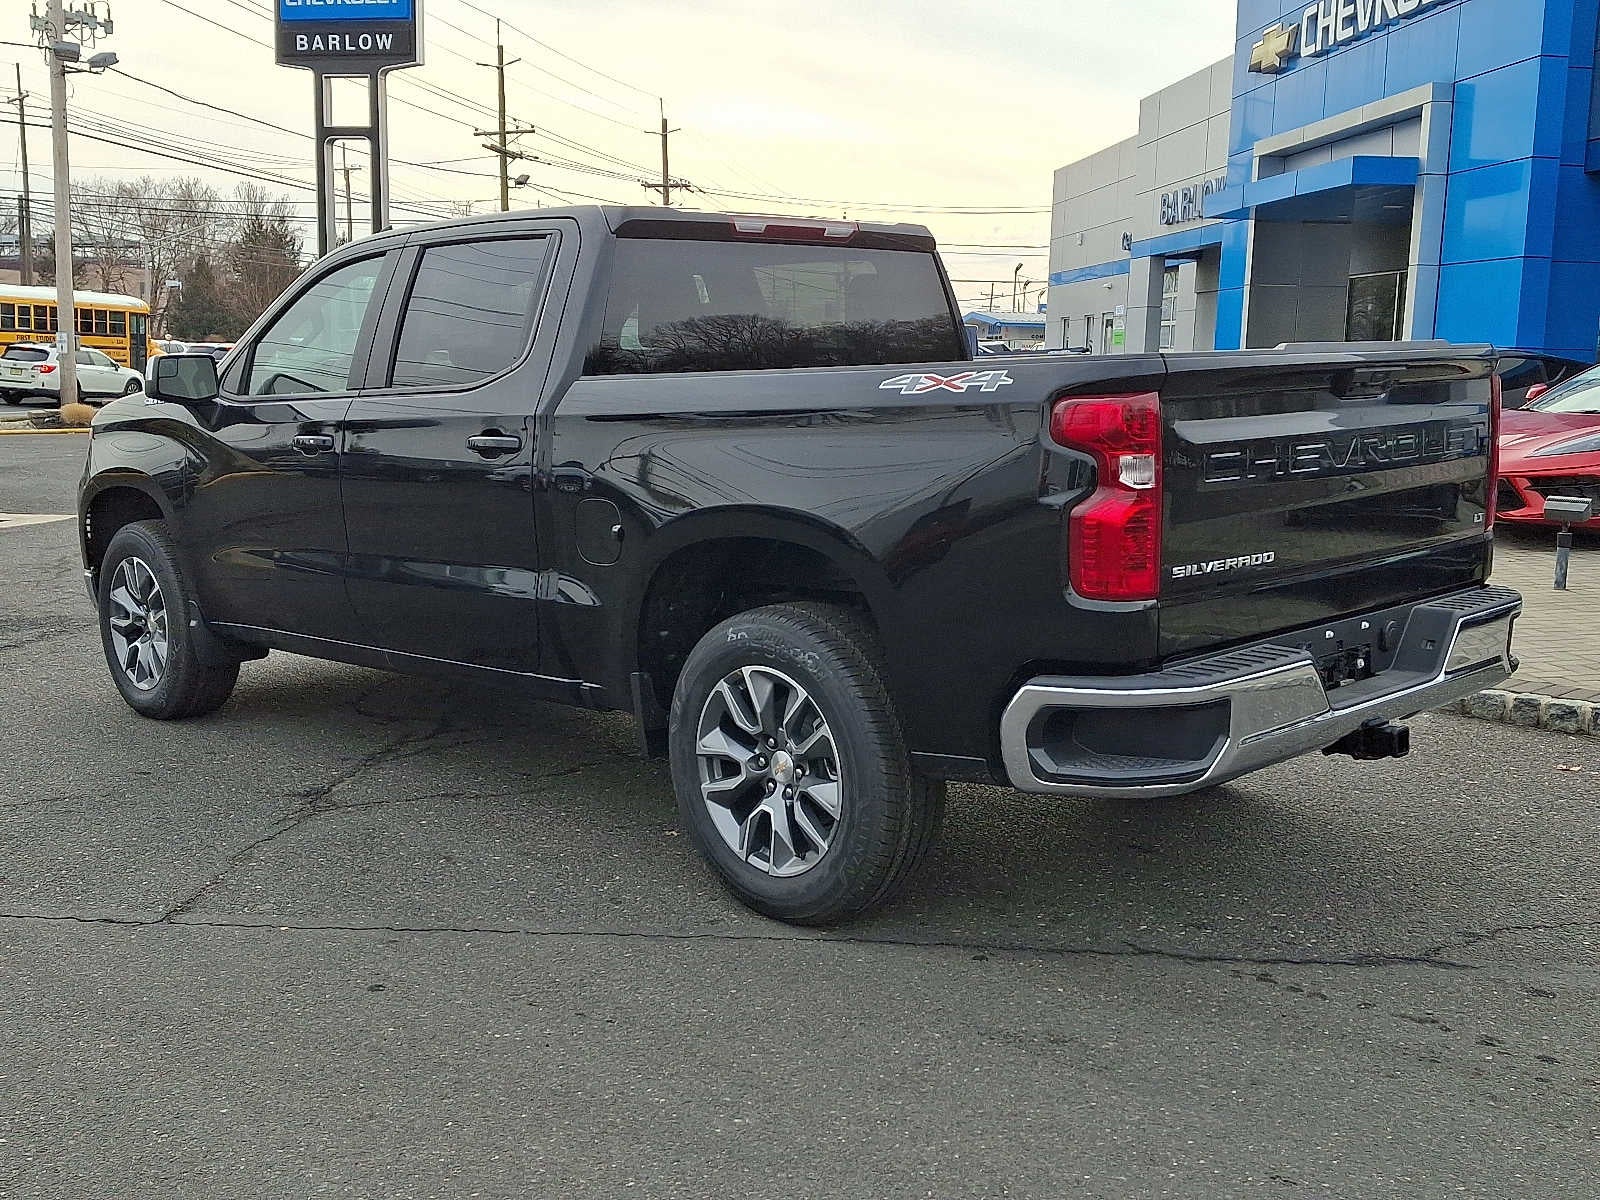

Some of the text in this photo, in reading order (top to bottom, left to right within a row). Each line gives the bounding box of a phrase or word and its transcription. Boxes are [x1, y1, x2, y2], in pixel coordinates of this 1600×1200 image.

[296, 34, 393, 51] BARLOW
[1204, 421, 1488, 482] CHEVROLET
[1171, 551, 1275, 579] SILVERADO
